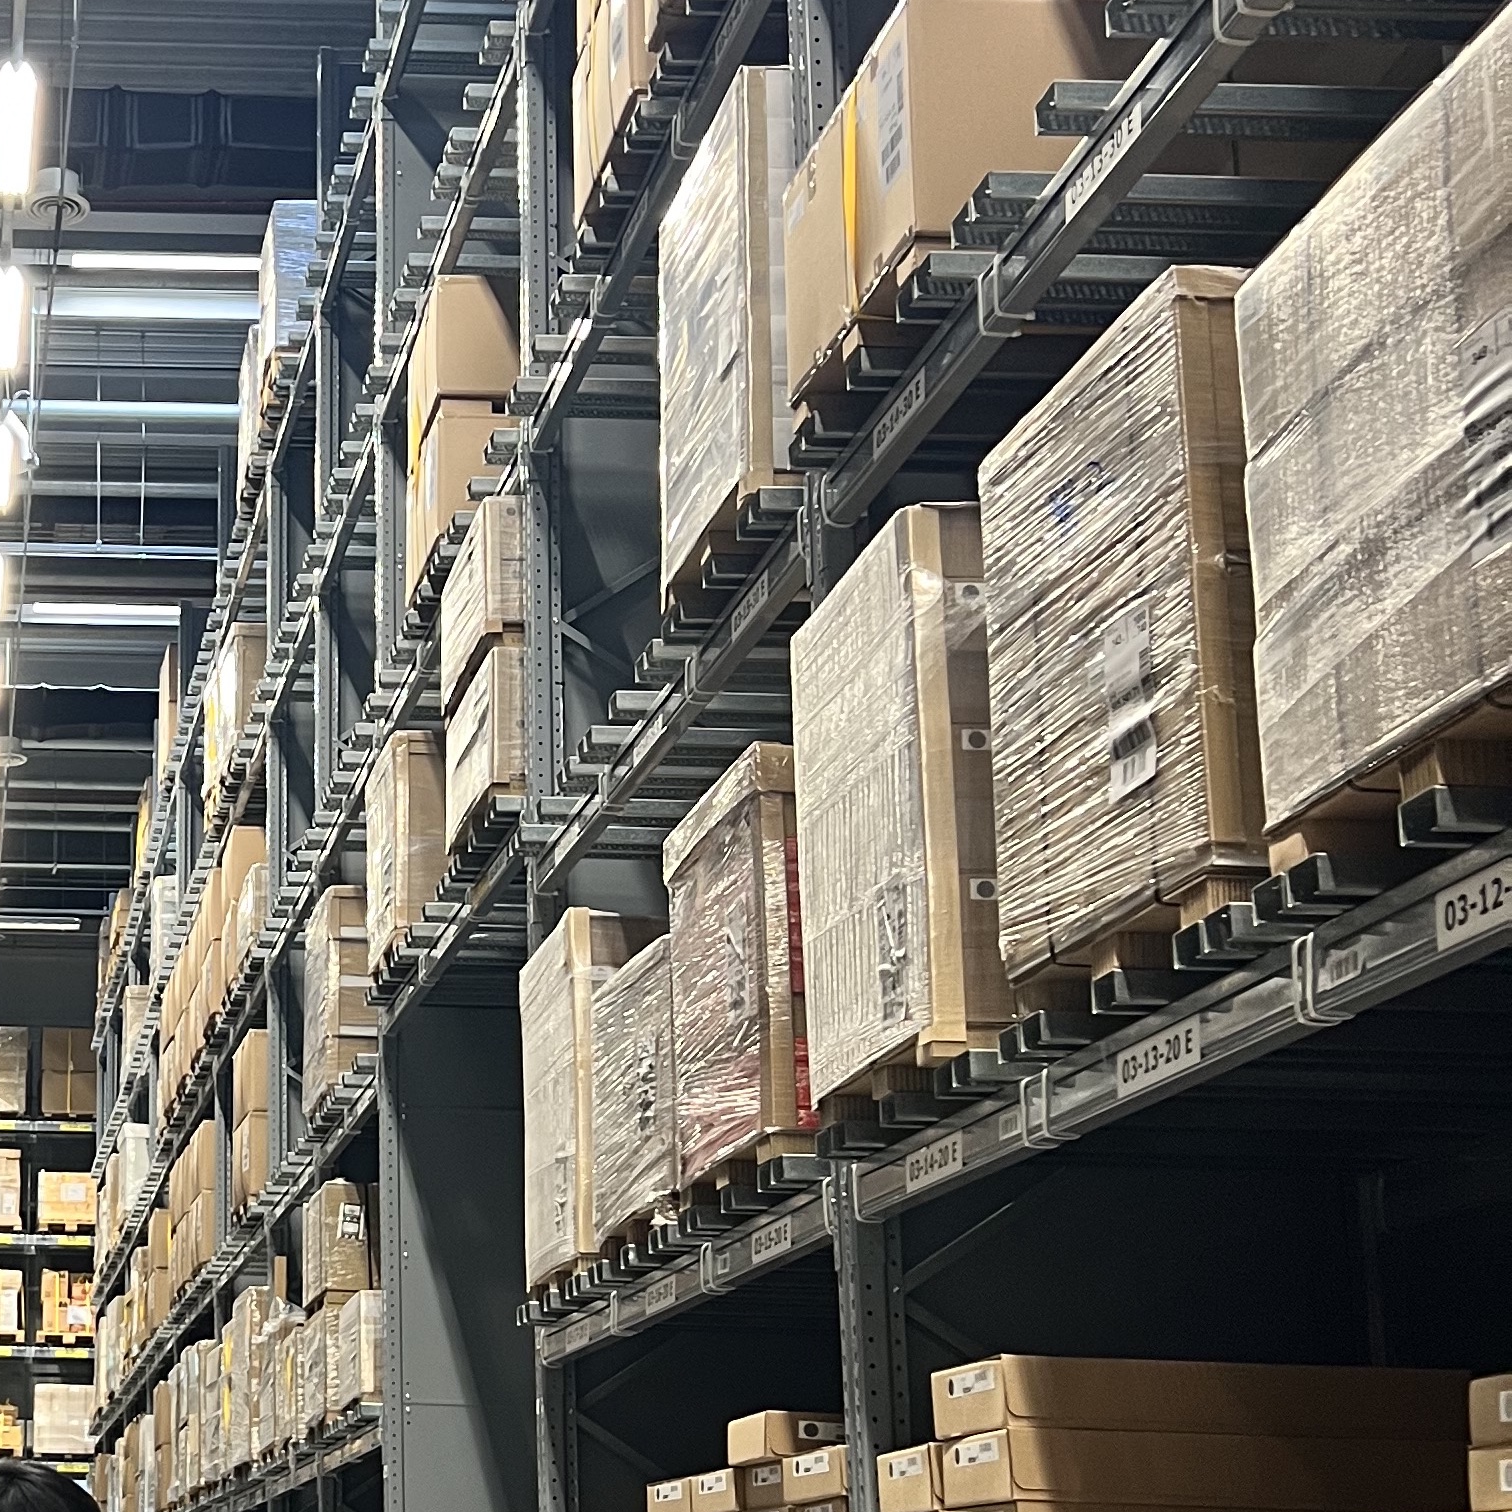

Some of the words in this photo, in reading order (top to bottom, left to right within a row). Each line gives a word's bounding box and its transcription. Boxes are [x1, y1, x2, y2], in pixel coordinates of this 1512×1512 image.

[1128, 118, 1134, 136] E
[915, 379, 921, 401] E
[1121, 1033, 1181, 1084] 03-13-20
[1184, 1027, 1193, 1055] E
[908, 1144, 950, 1182] 03-14-20
[951, 1141, 958, 1162] E
[783, 1222, 788, 1242] E
